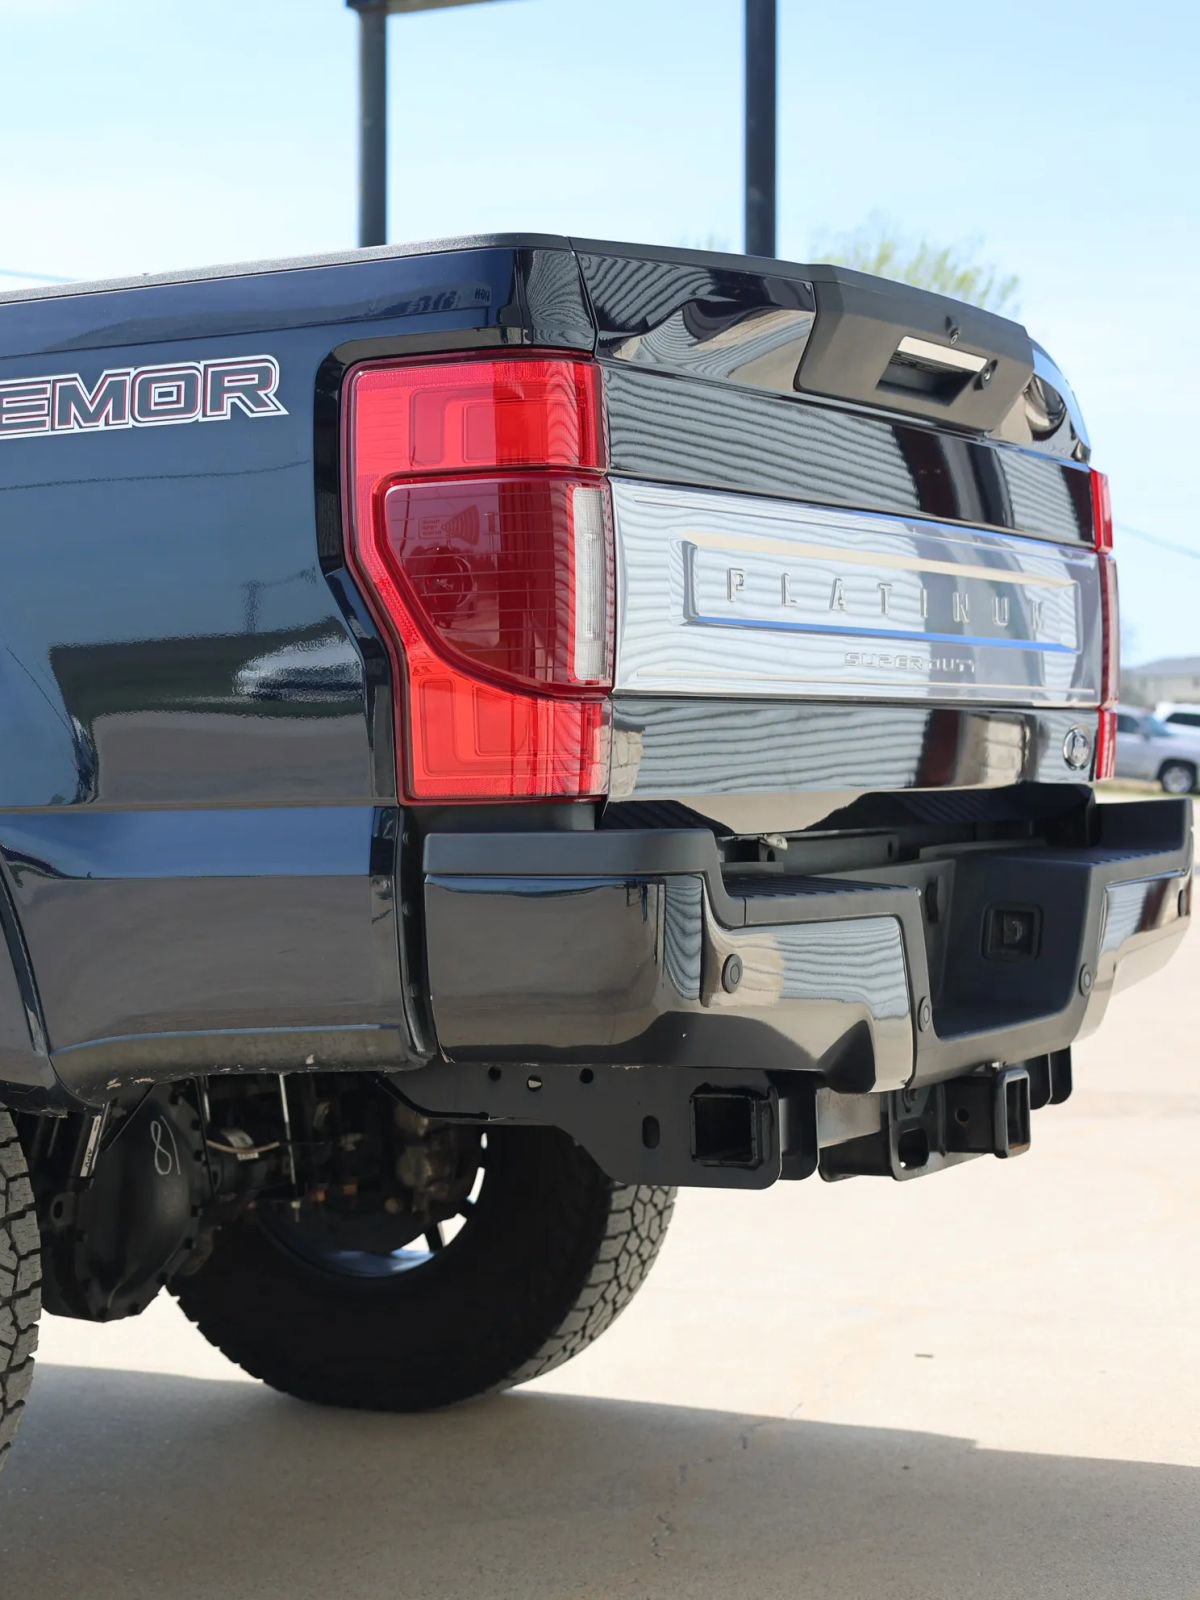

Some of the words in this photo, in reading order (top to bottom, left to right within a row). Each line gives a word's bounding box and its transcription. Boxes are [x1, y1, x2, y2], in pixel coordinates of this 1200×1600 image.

[726, 567, 1046, 631] PLATINUM
[844, 651, 923, 671] SUPER
[925, 657, 976, 674] DUTY
